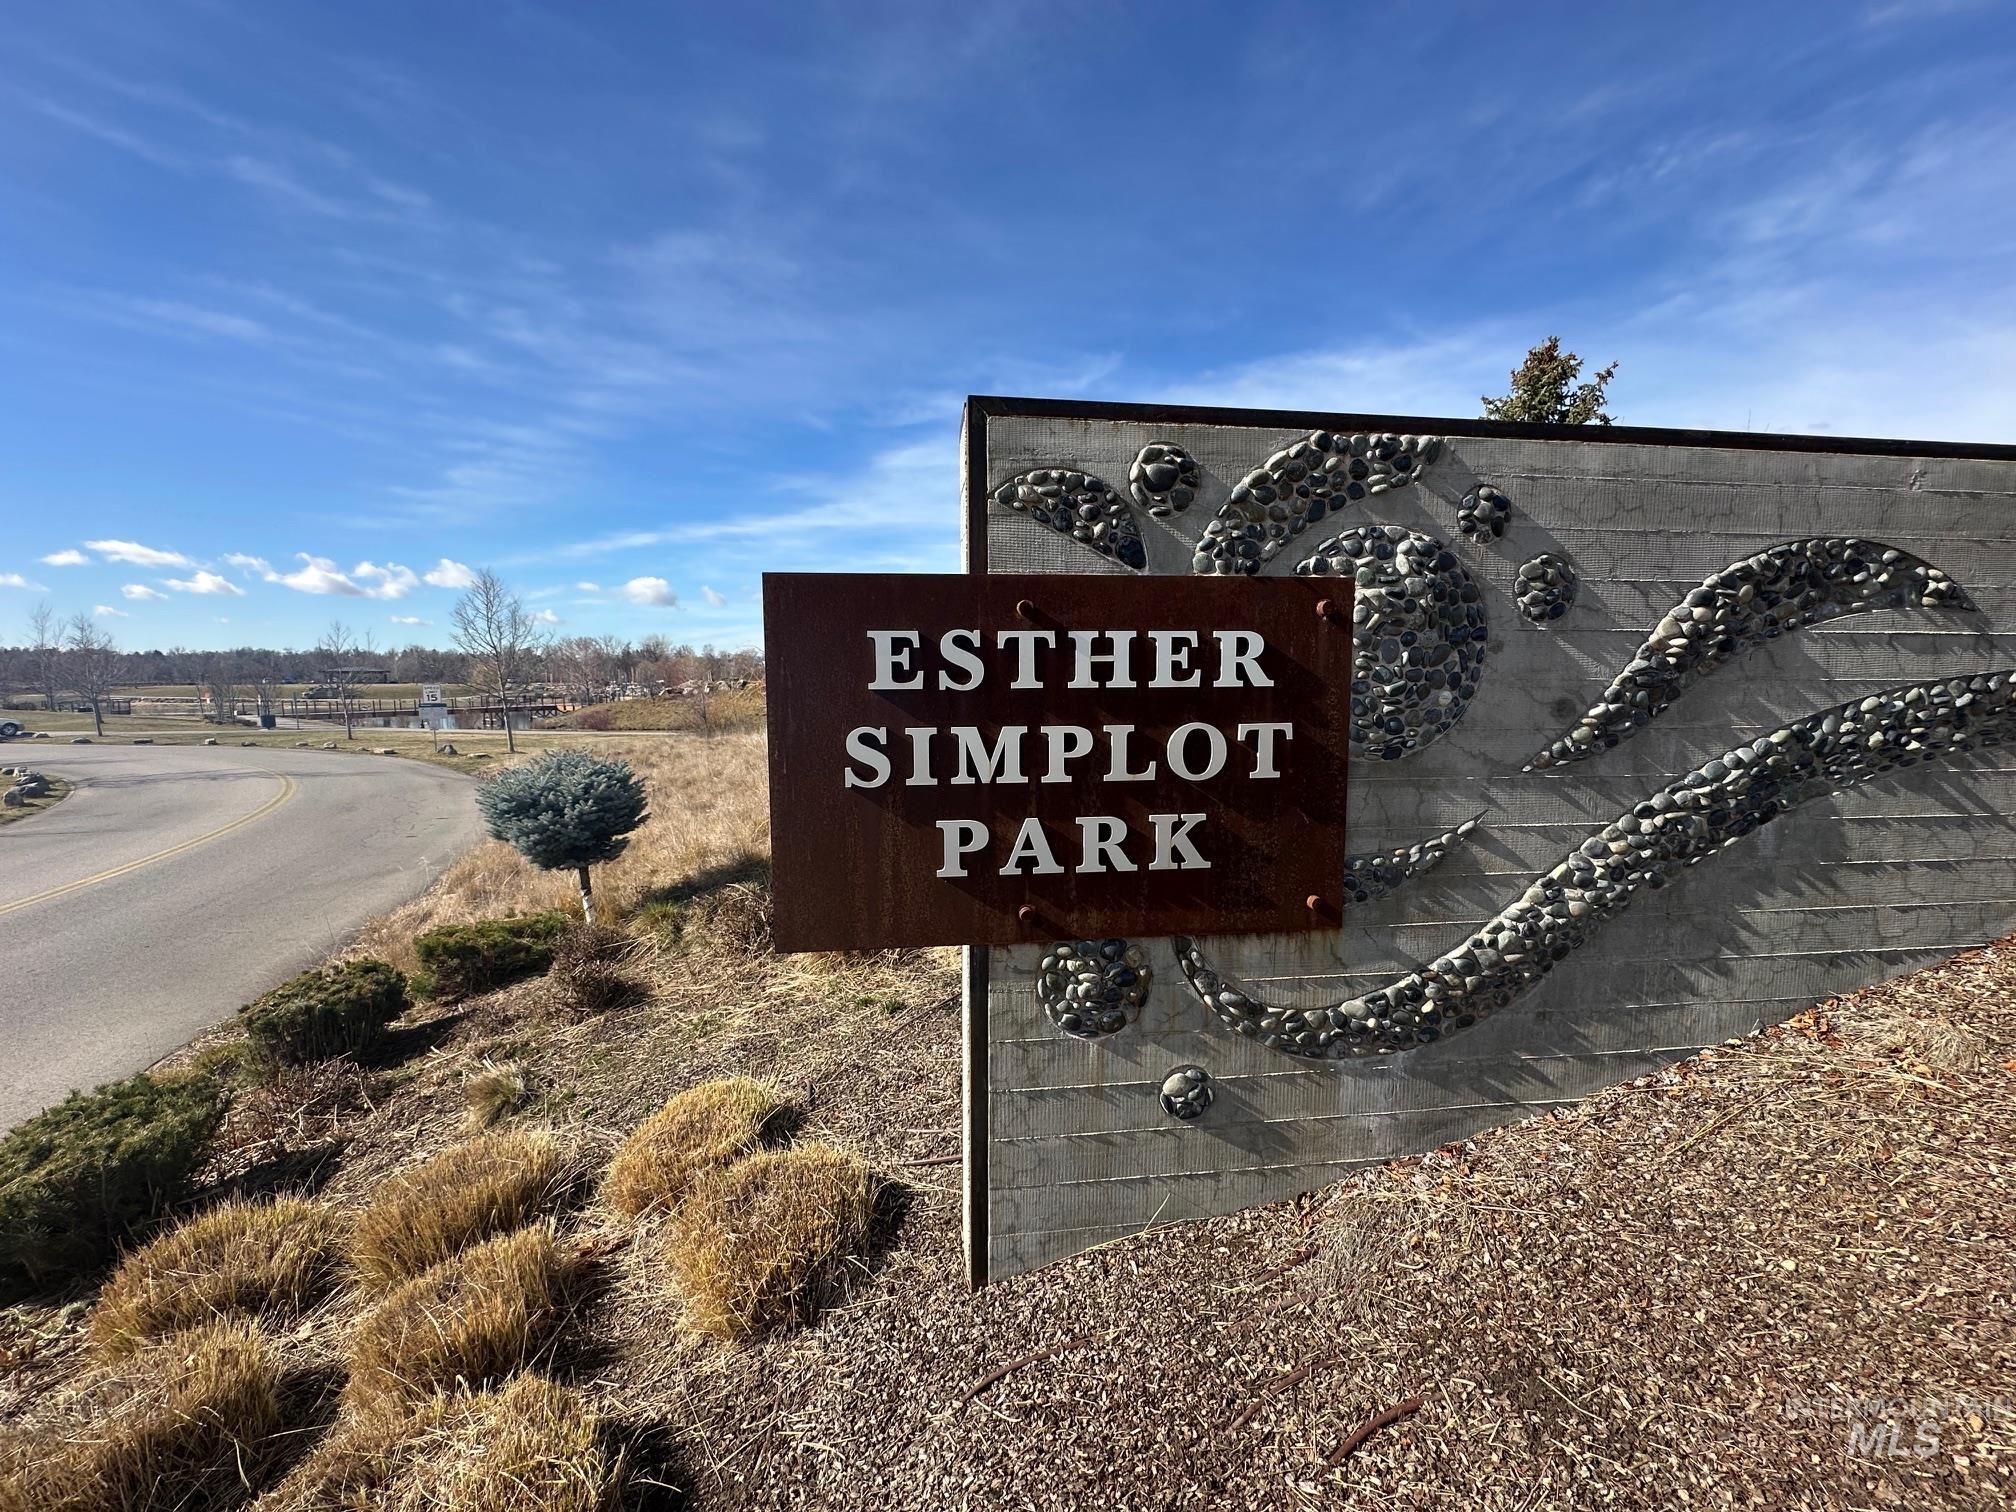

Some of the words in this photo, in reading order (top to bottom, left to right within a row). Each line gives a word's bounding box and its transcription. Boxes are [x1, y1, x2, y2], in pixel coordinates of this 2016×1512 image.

[866, 628, 1275, 691] ESTHER
[426, 694, 438, 702] 15
[844, 721, 1294, 789] SIMPLOT
[935, 812, 1212, 878] PARK
